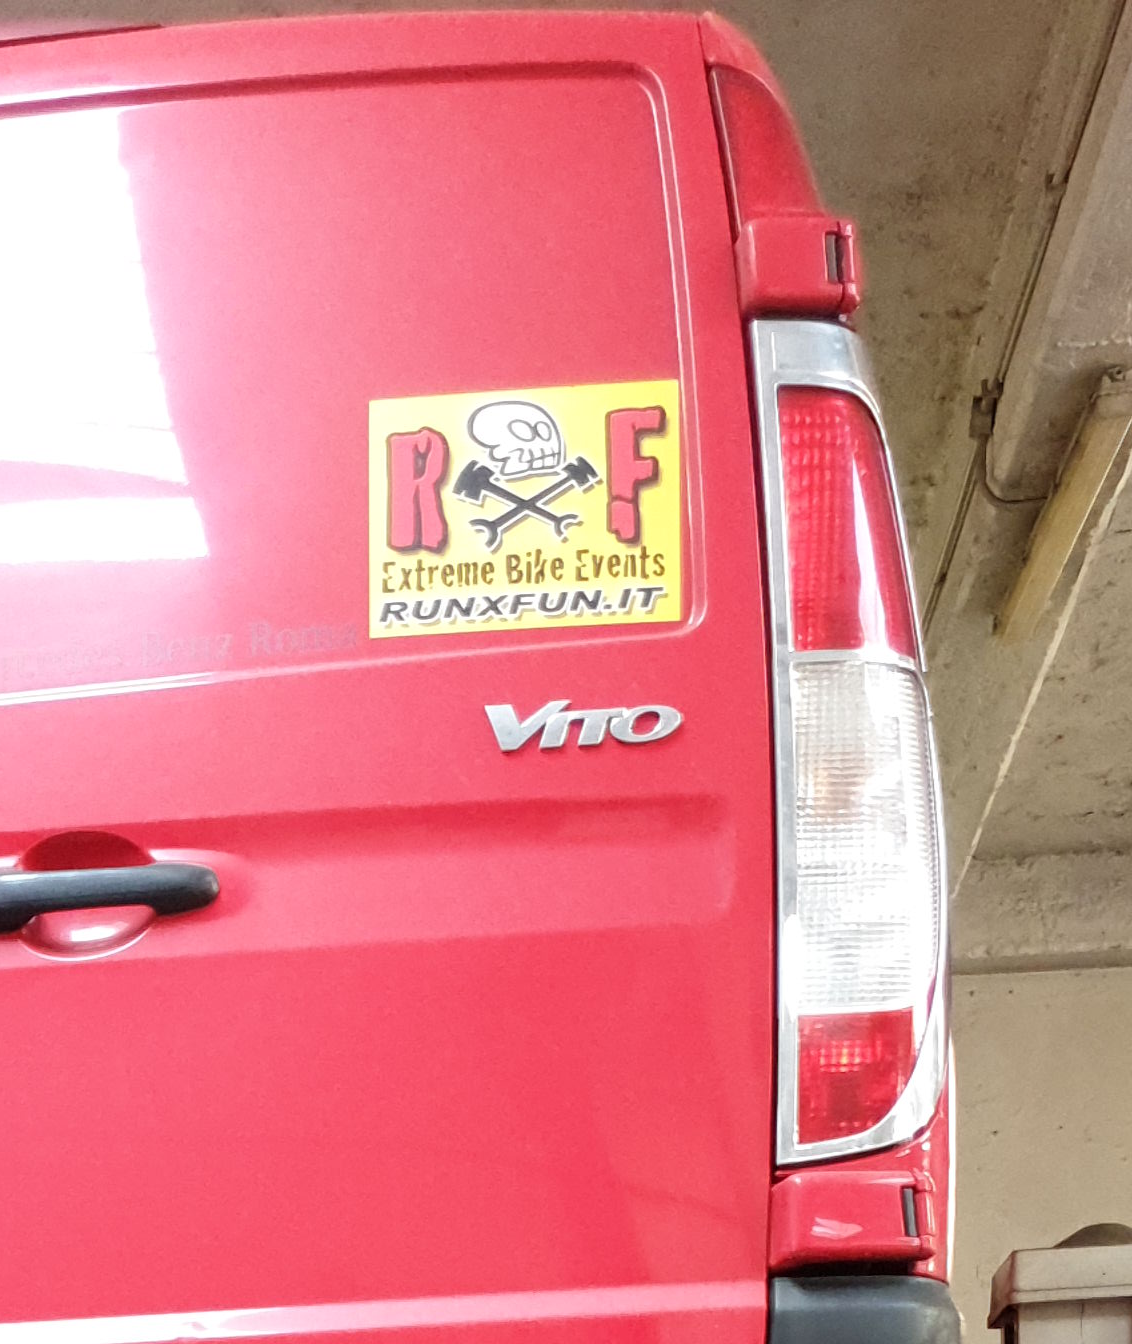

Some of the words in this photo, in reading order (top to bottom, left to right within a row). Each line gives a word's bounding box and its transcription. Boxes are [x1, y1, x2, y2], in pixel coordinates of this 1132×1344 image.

[385, 426, 450, 554] R
[605, 405, 667, 544] F
[381, 558, 495, 593] Extreme
[505, 548, 565, 585] Bike
[575, 545, 666, 582] Events
[379, 586, 666, 623] RUNXFUN.IT
